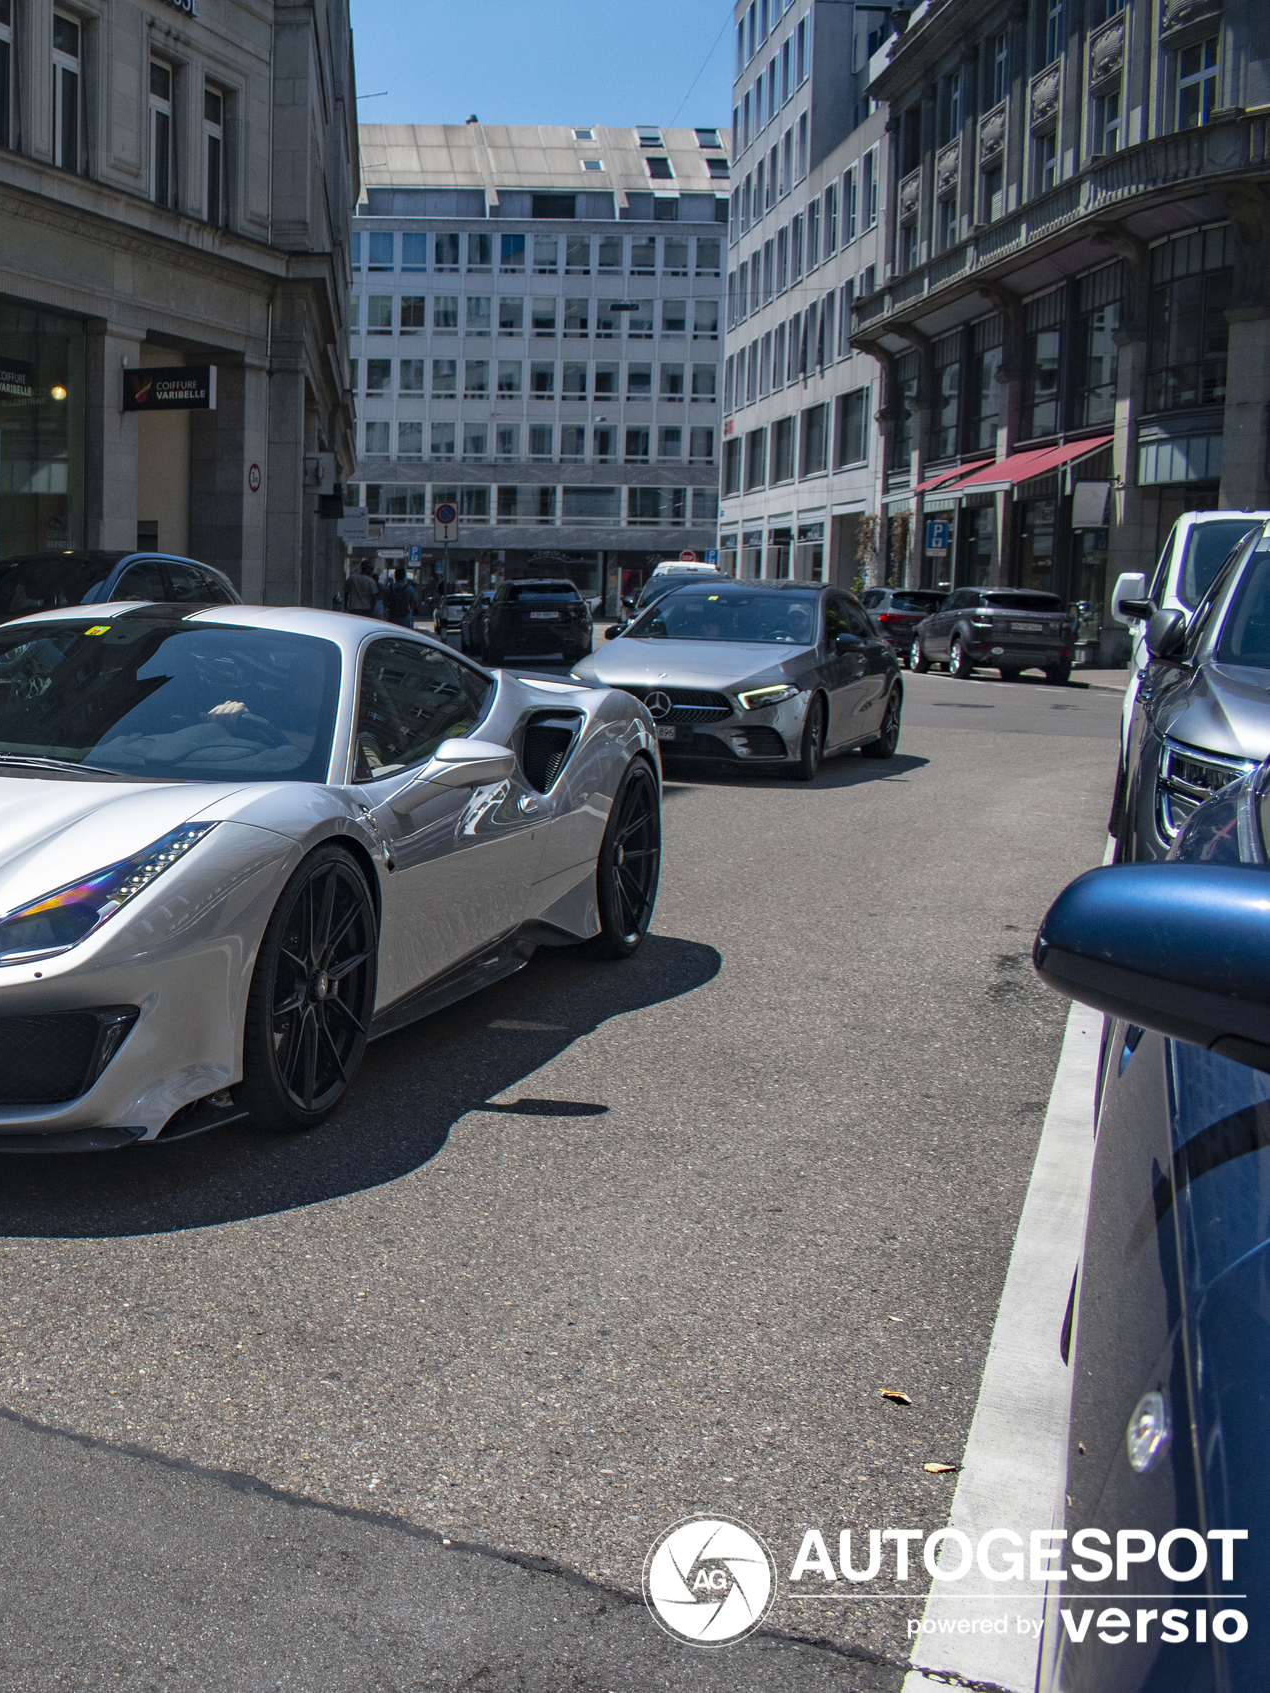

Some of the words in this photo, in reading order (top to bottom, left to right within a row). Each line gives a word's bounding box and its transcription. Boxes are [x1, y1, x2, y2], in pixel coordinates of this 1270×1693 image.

[156, 380, 198, 391] COIFFURE
[156, 389, 206, 400] VARIBELLE
[933, 524, 944, 538] P
